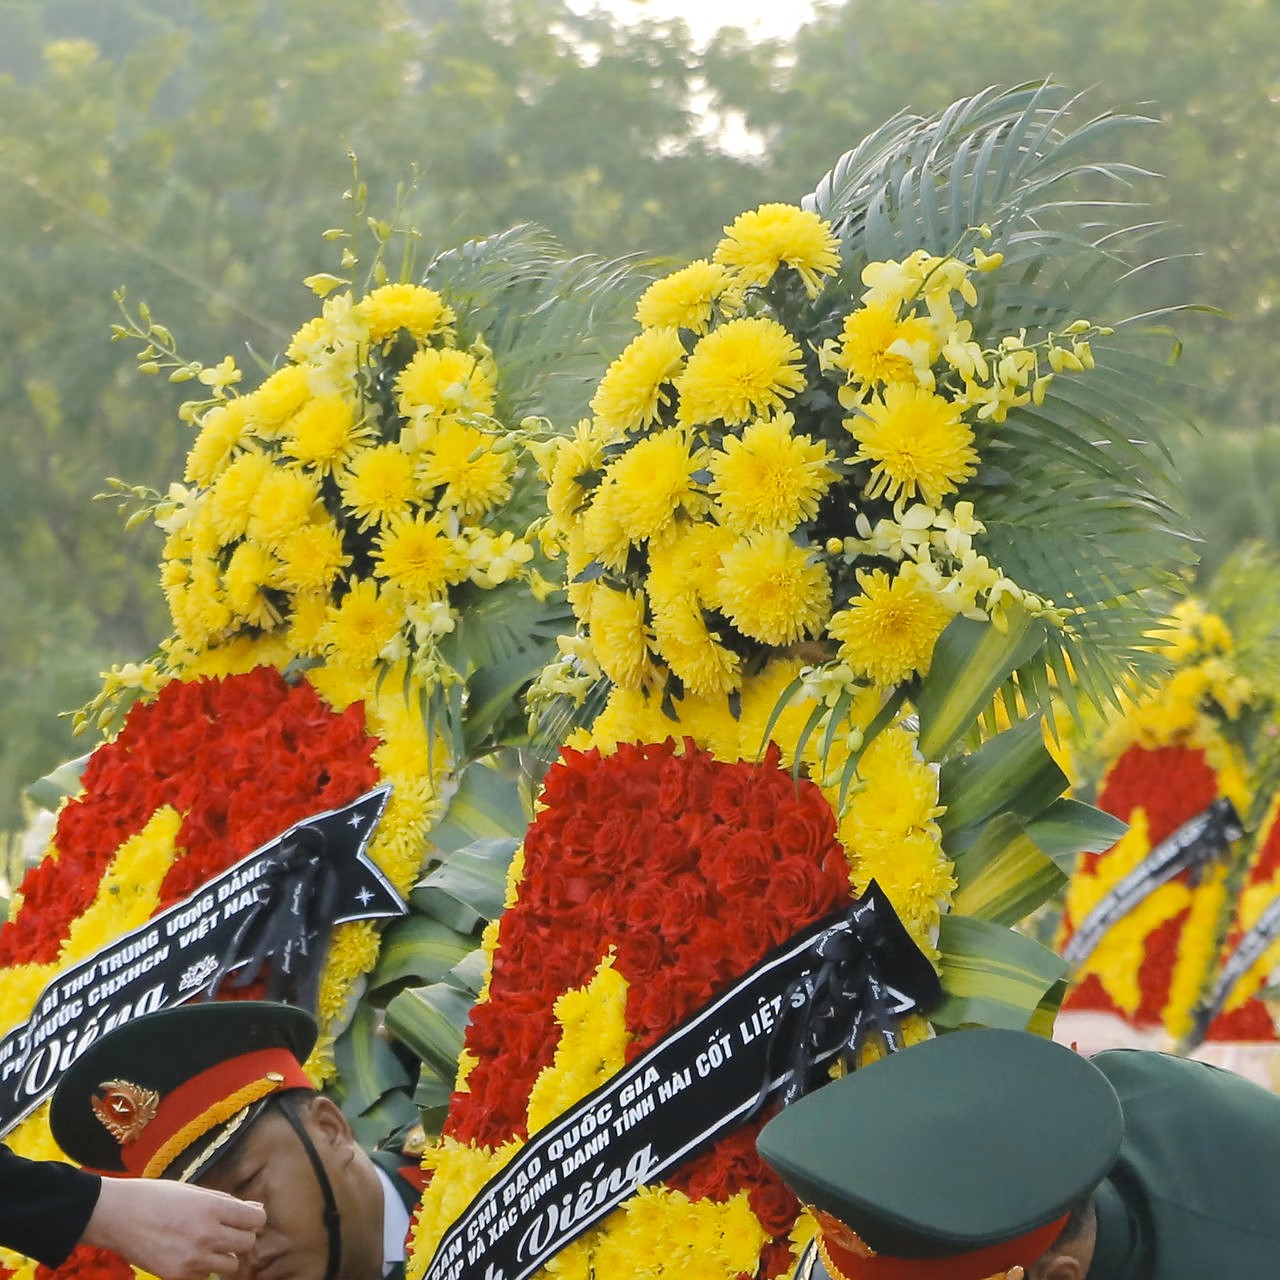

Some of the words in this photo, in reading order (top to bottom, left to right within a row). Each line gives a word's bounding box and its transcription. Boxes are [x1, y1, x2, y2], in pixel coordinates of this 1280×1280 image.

[33, 999, 83, 1048] NƯỚC
[87, 945, 170, 1007] CHXHCN
[179, 911, 220, 949] VIỆT
[42, 987, 59, 1016] BÍ
[62, 963, 98, 1000] THƯ
[99, 930, 160, 976] TRUNG
[166, 894, 214, 937] ƯƠNG
[467, 1194, 498, 1242] CHỈ
[503, 1157, 542, 1206] ĐẠO
[547, 1103, 613, 1161] QUỐC
[619, 1066, 660, 1108] GIA
[468, 1236, 486, 1266] VÀ
[488, 1206, 519, 1246] XÁC
[520, 1168, 558, 1215] ĐỊNH
[562, 1129, 610, 1178] DANH
[612, 1096, 655, 1138] TÍNH
[658, 1068, 693, 1104] HÀI
[695, 1029, 733, 1078] CỐT
[740, 995, 782, 1045] LIỆT
[517, 1142, 659, 1263] Viếng
